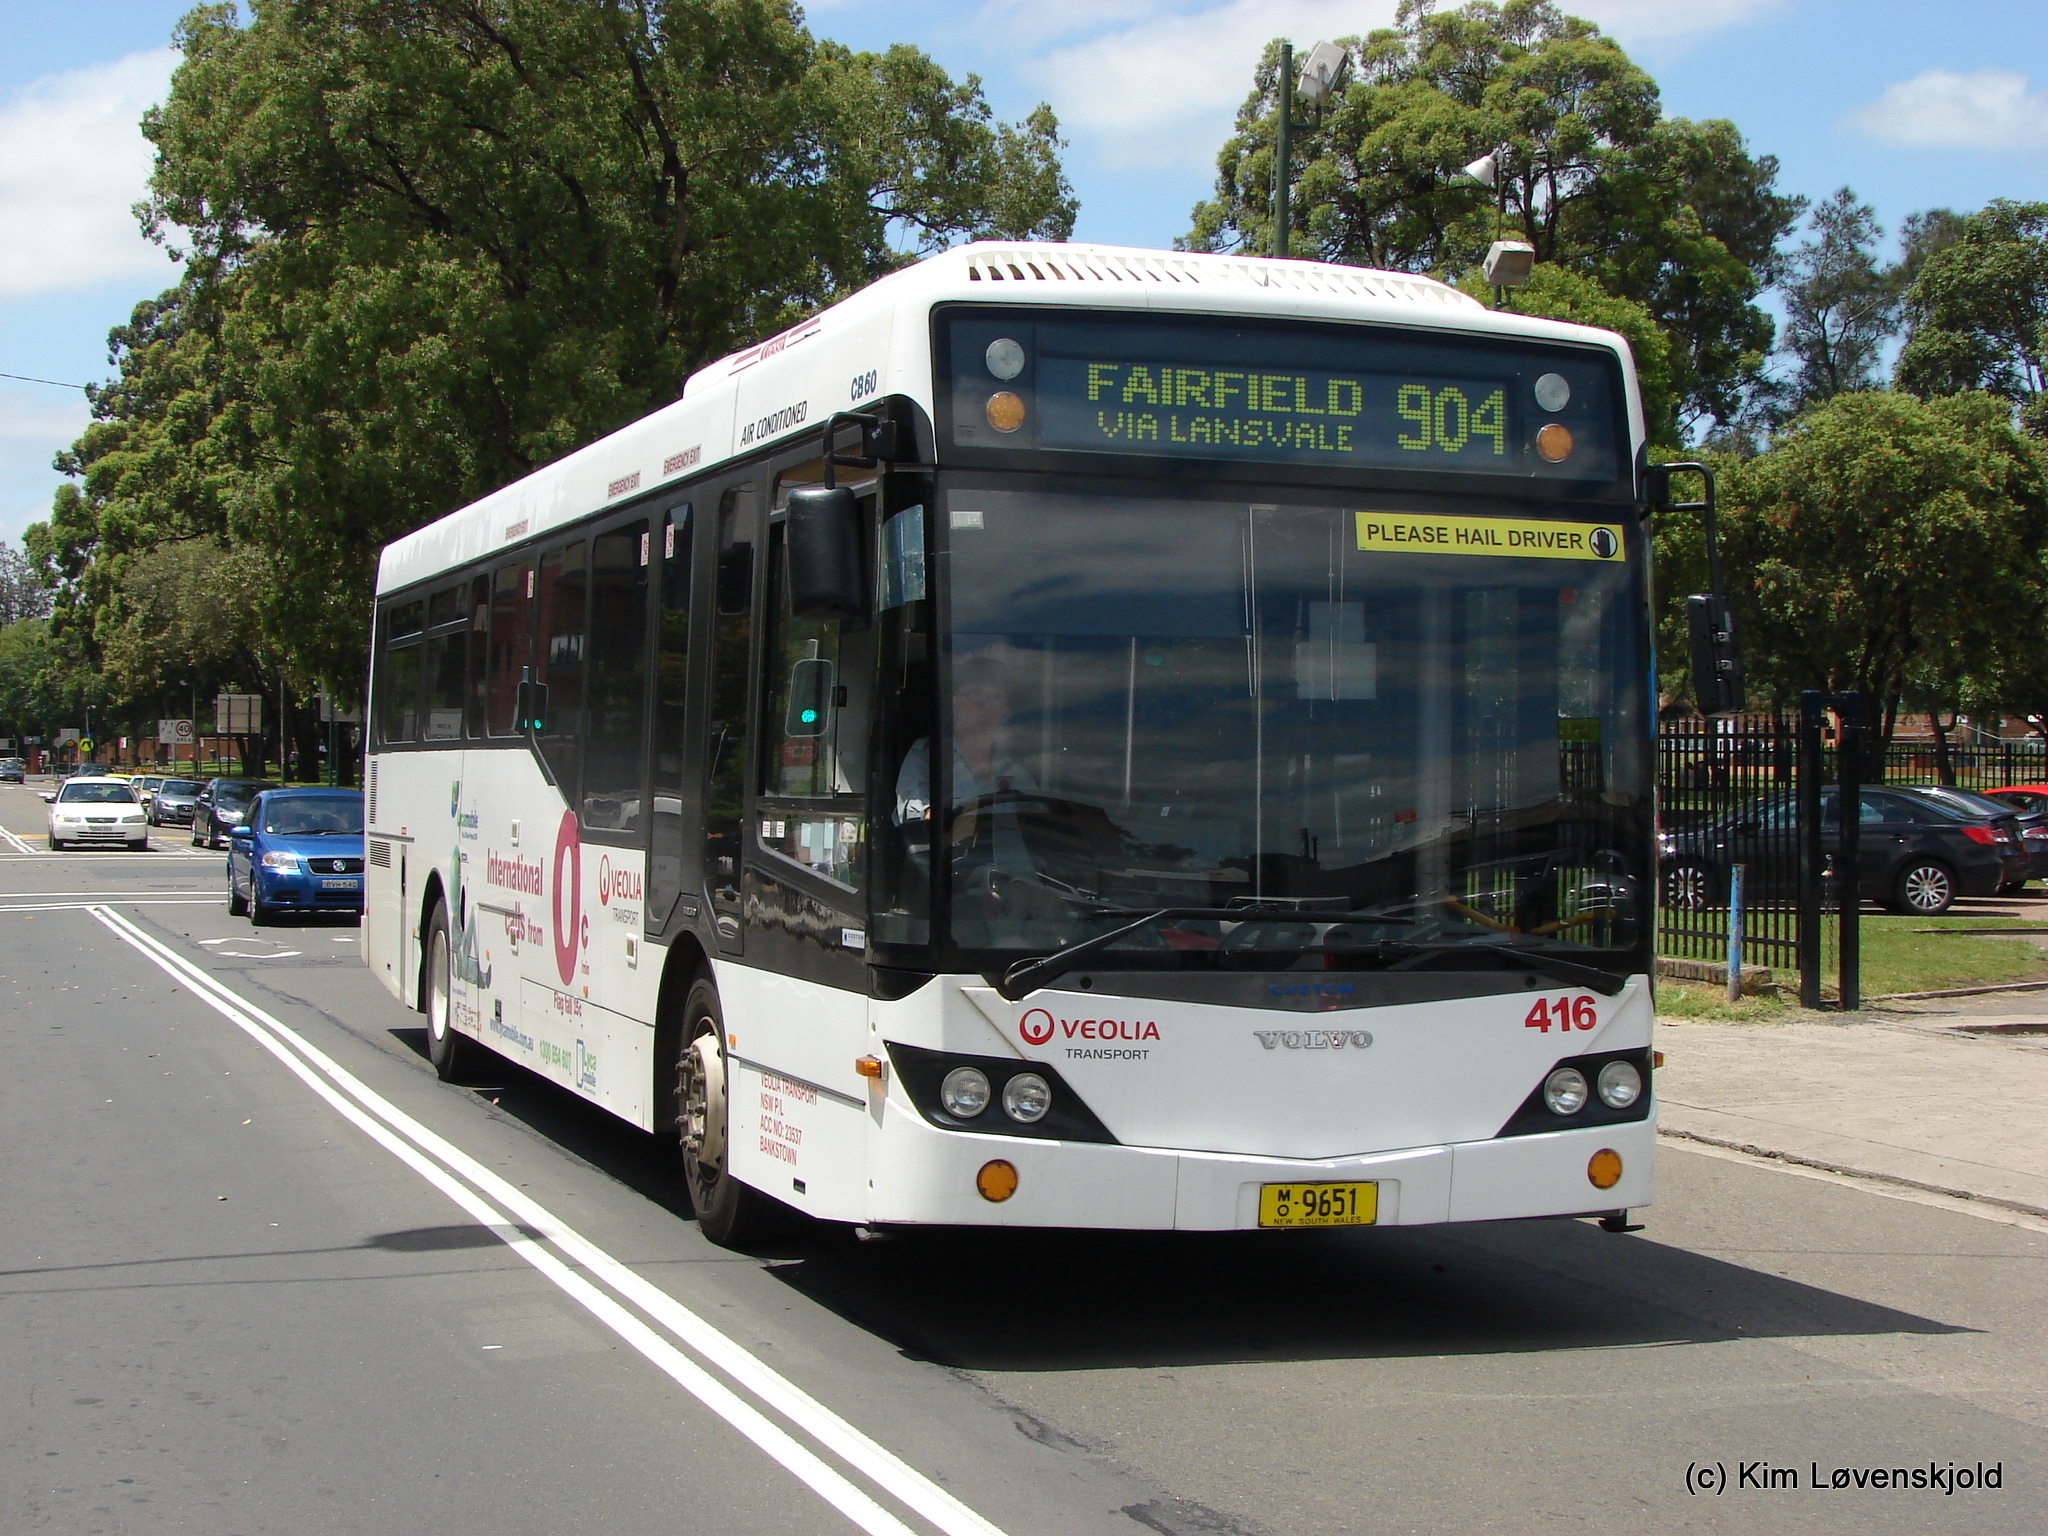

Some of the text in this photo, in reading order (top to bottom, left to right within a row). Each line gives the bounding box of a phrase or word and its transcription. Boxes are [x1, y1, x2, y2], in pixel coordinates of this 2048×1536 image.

[851, 369, 877, 401] CB60
[740, 401, 808, 447] AIR CONDITIONED
[1087, 363, 1504, 455] FAIRFIELD 904
[1098, 411, 1353, 452] VIA LANSVALE
[1367, 524, 1584, 549] PLEASE HAIL DRIVER
[179, 725, 190, 733] 40
[487, 848, 543, 896] International
[611, 870, 642, 901] VEOLIA
[528, 917, 544, 947] from
[1060, 1019, 1161, 1041] VEOLIA
[1525, 995, 1597, 1034] 416
[1065, 1047, 1150, 1061] TRANSPORT
[1253, 1029, 1374, 1050] VOLVO
[760, 1135, 797, 1167] BANKSTOWN
[1299, 1217, 1329, 1225] SOUTH
